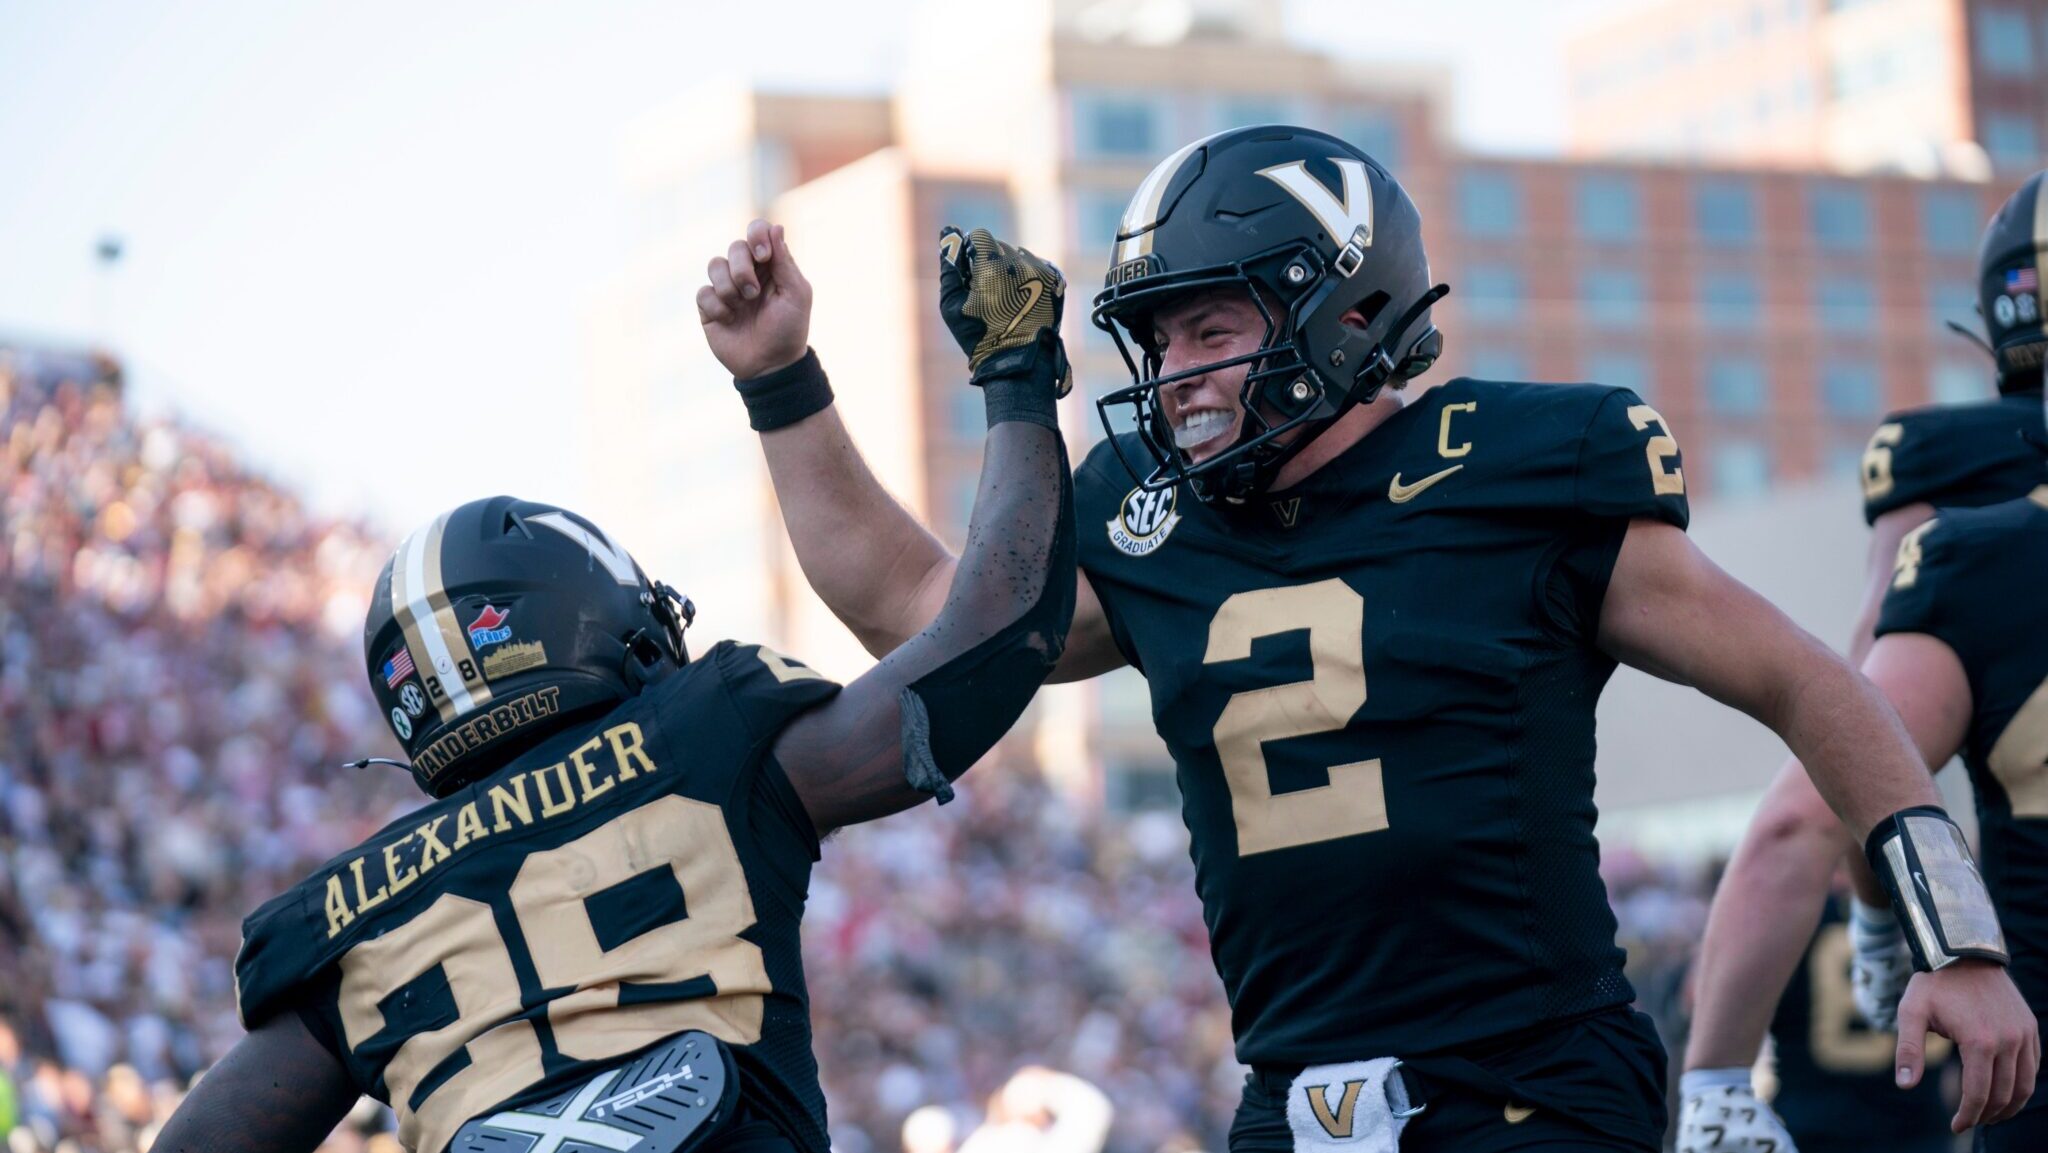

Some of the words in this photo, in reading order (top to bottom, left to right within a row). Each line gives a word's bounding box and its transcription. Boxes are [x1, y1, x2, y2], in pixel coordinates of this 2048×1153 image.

[1253, 157, 1374, 249] V
[1438, 401, 1477, 458] C
[1627, 404, 1685, 496] 2
[1113, 528, 1167, 553] GRADUATE
[1125, 486, 1173, 535] SEC
[1270, 497, 1301, 528] V
[412, 685, 560, 781] VANDERBILT
[1203, 577, 1389, 857] 2
[326, 721, 657, 939] ALEXANDER
[337, 794, 772, 1153] 28
[1303, 1078, 1368, 1139] V
